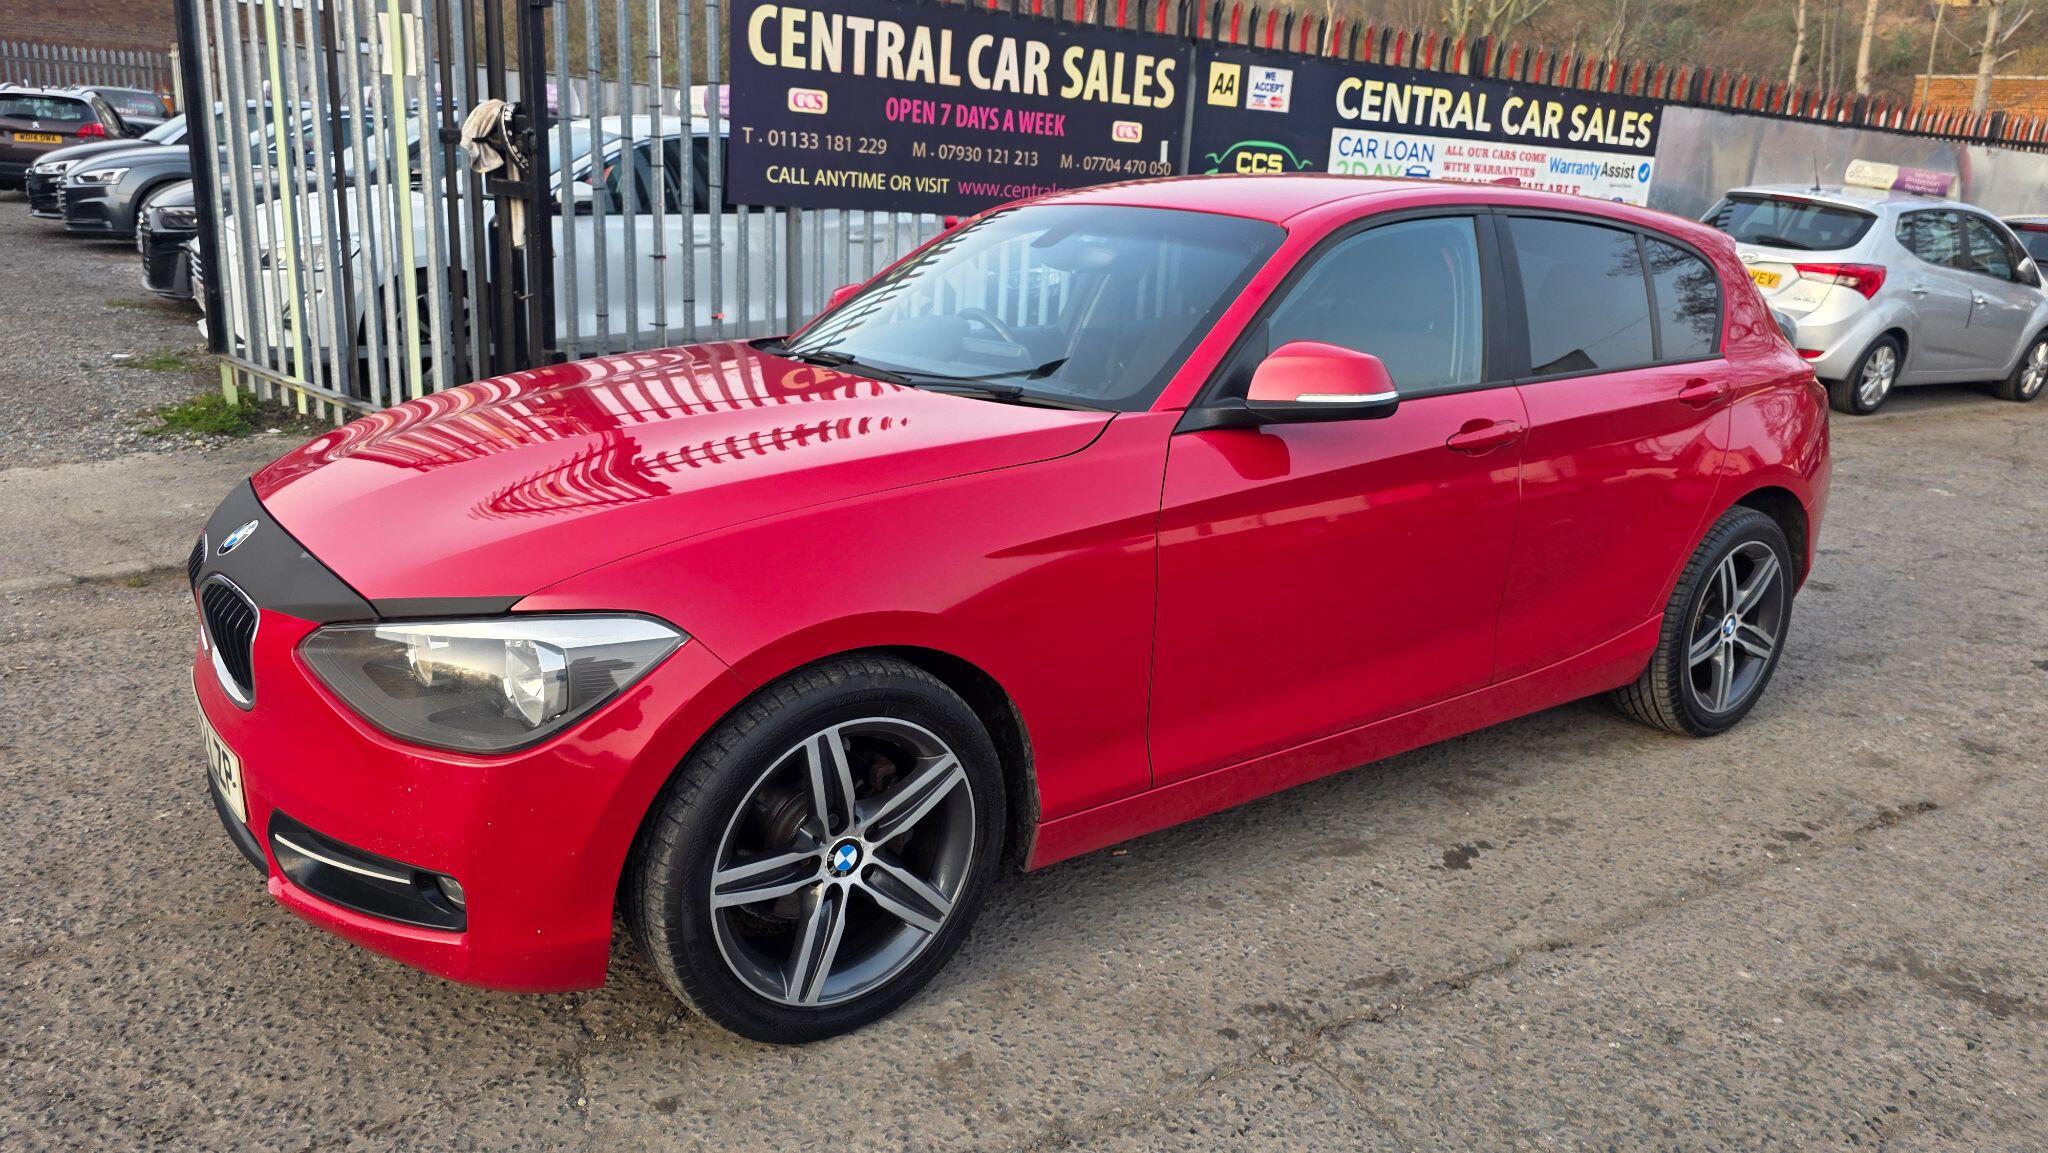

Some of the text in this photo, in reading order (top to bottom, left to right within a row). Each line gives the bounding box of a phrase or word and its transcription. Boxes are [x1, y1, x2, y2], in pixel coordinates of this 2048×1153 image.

[748, 4, 1176, 109] CENTRAL CAR SALES
[1212, 72, 1235, 95] AA
[1254, 82, 1284, 93] ACCEPT
[1264, 71, 1277, 81] WE
[793, 92, 823, 110] CCS
[1335, 76, 1654, 148] CENTRAL CAR SALES
[885, 97, 1066, 136] OPEN 7 DAYS A WEEK
[767, 130, 819, 149] 01133
[826, 134, 851, 152] 181
[858, 138, 887, 155] 229
[1338, 136, 1435, 163] CAR LOAN
[1444, 145, 1547, 163] ALL OUR CARS COME
[938, 144, 982, 162] 07930
[986, 148, 1009, 164] 121
[1014, 150, 1039, 166] 213
[1083, 156, 1121, 172] 07704
[1124, 160, 1146, 174] 470
[1149, 161, 1171, 176] 050
[1235, 151, 1283, 174] CCS
[766, 165, 809, 186] CALL
[814, 169, 886, 190] ANYTIME
[889, 174, 911, 192] OR
[915, 176, 950, 194] VISIT
[1443, 161, 1536, 178] WITH WARRANTIES
